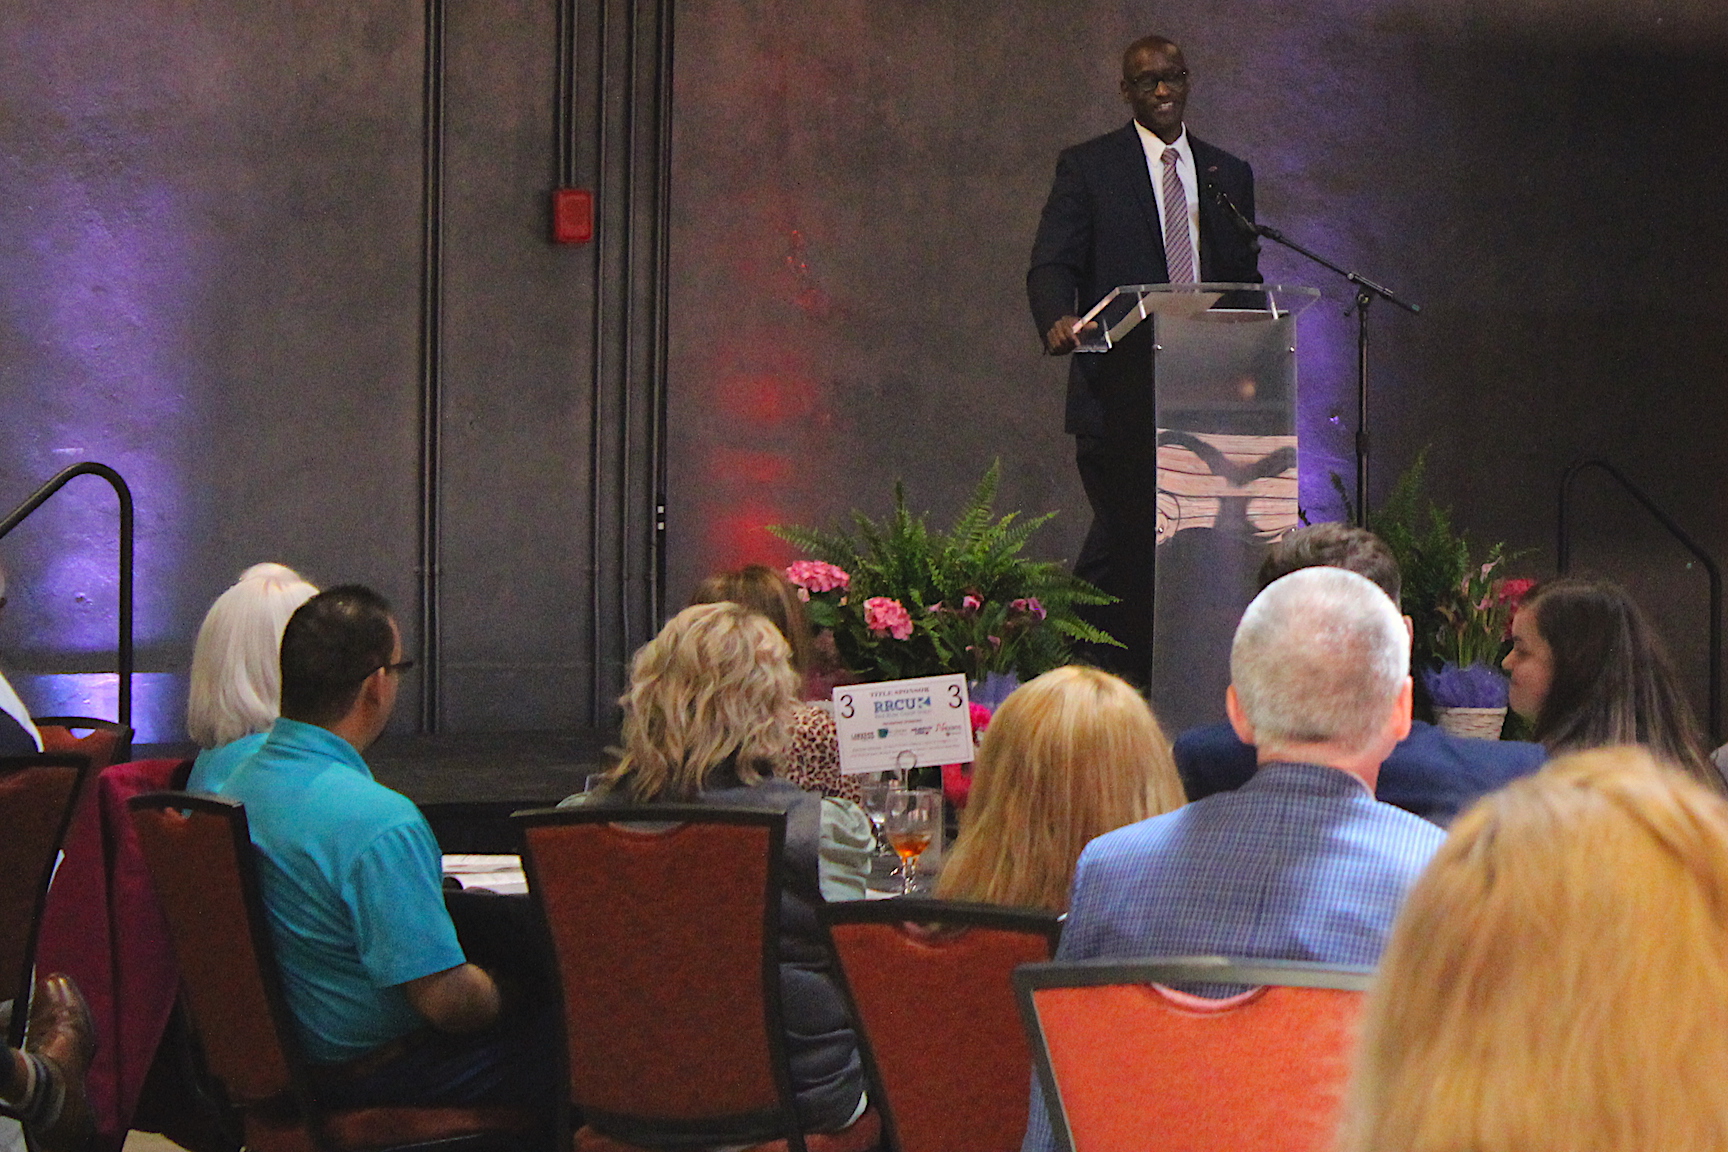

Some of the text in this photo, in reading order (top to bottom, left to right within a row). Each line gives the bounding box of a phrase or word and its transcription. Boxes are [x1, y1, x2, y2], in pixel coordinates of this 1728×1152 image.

[840, 694, 855, 719] 3
[874, 698, 916, 713] RRCU
[947, 684, 963, 709] 3
